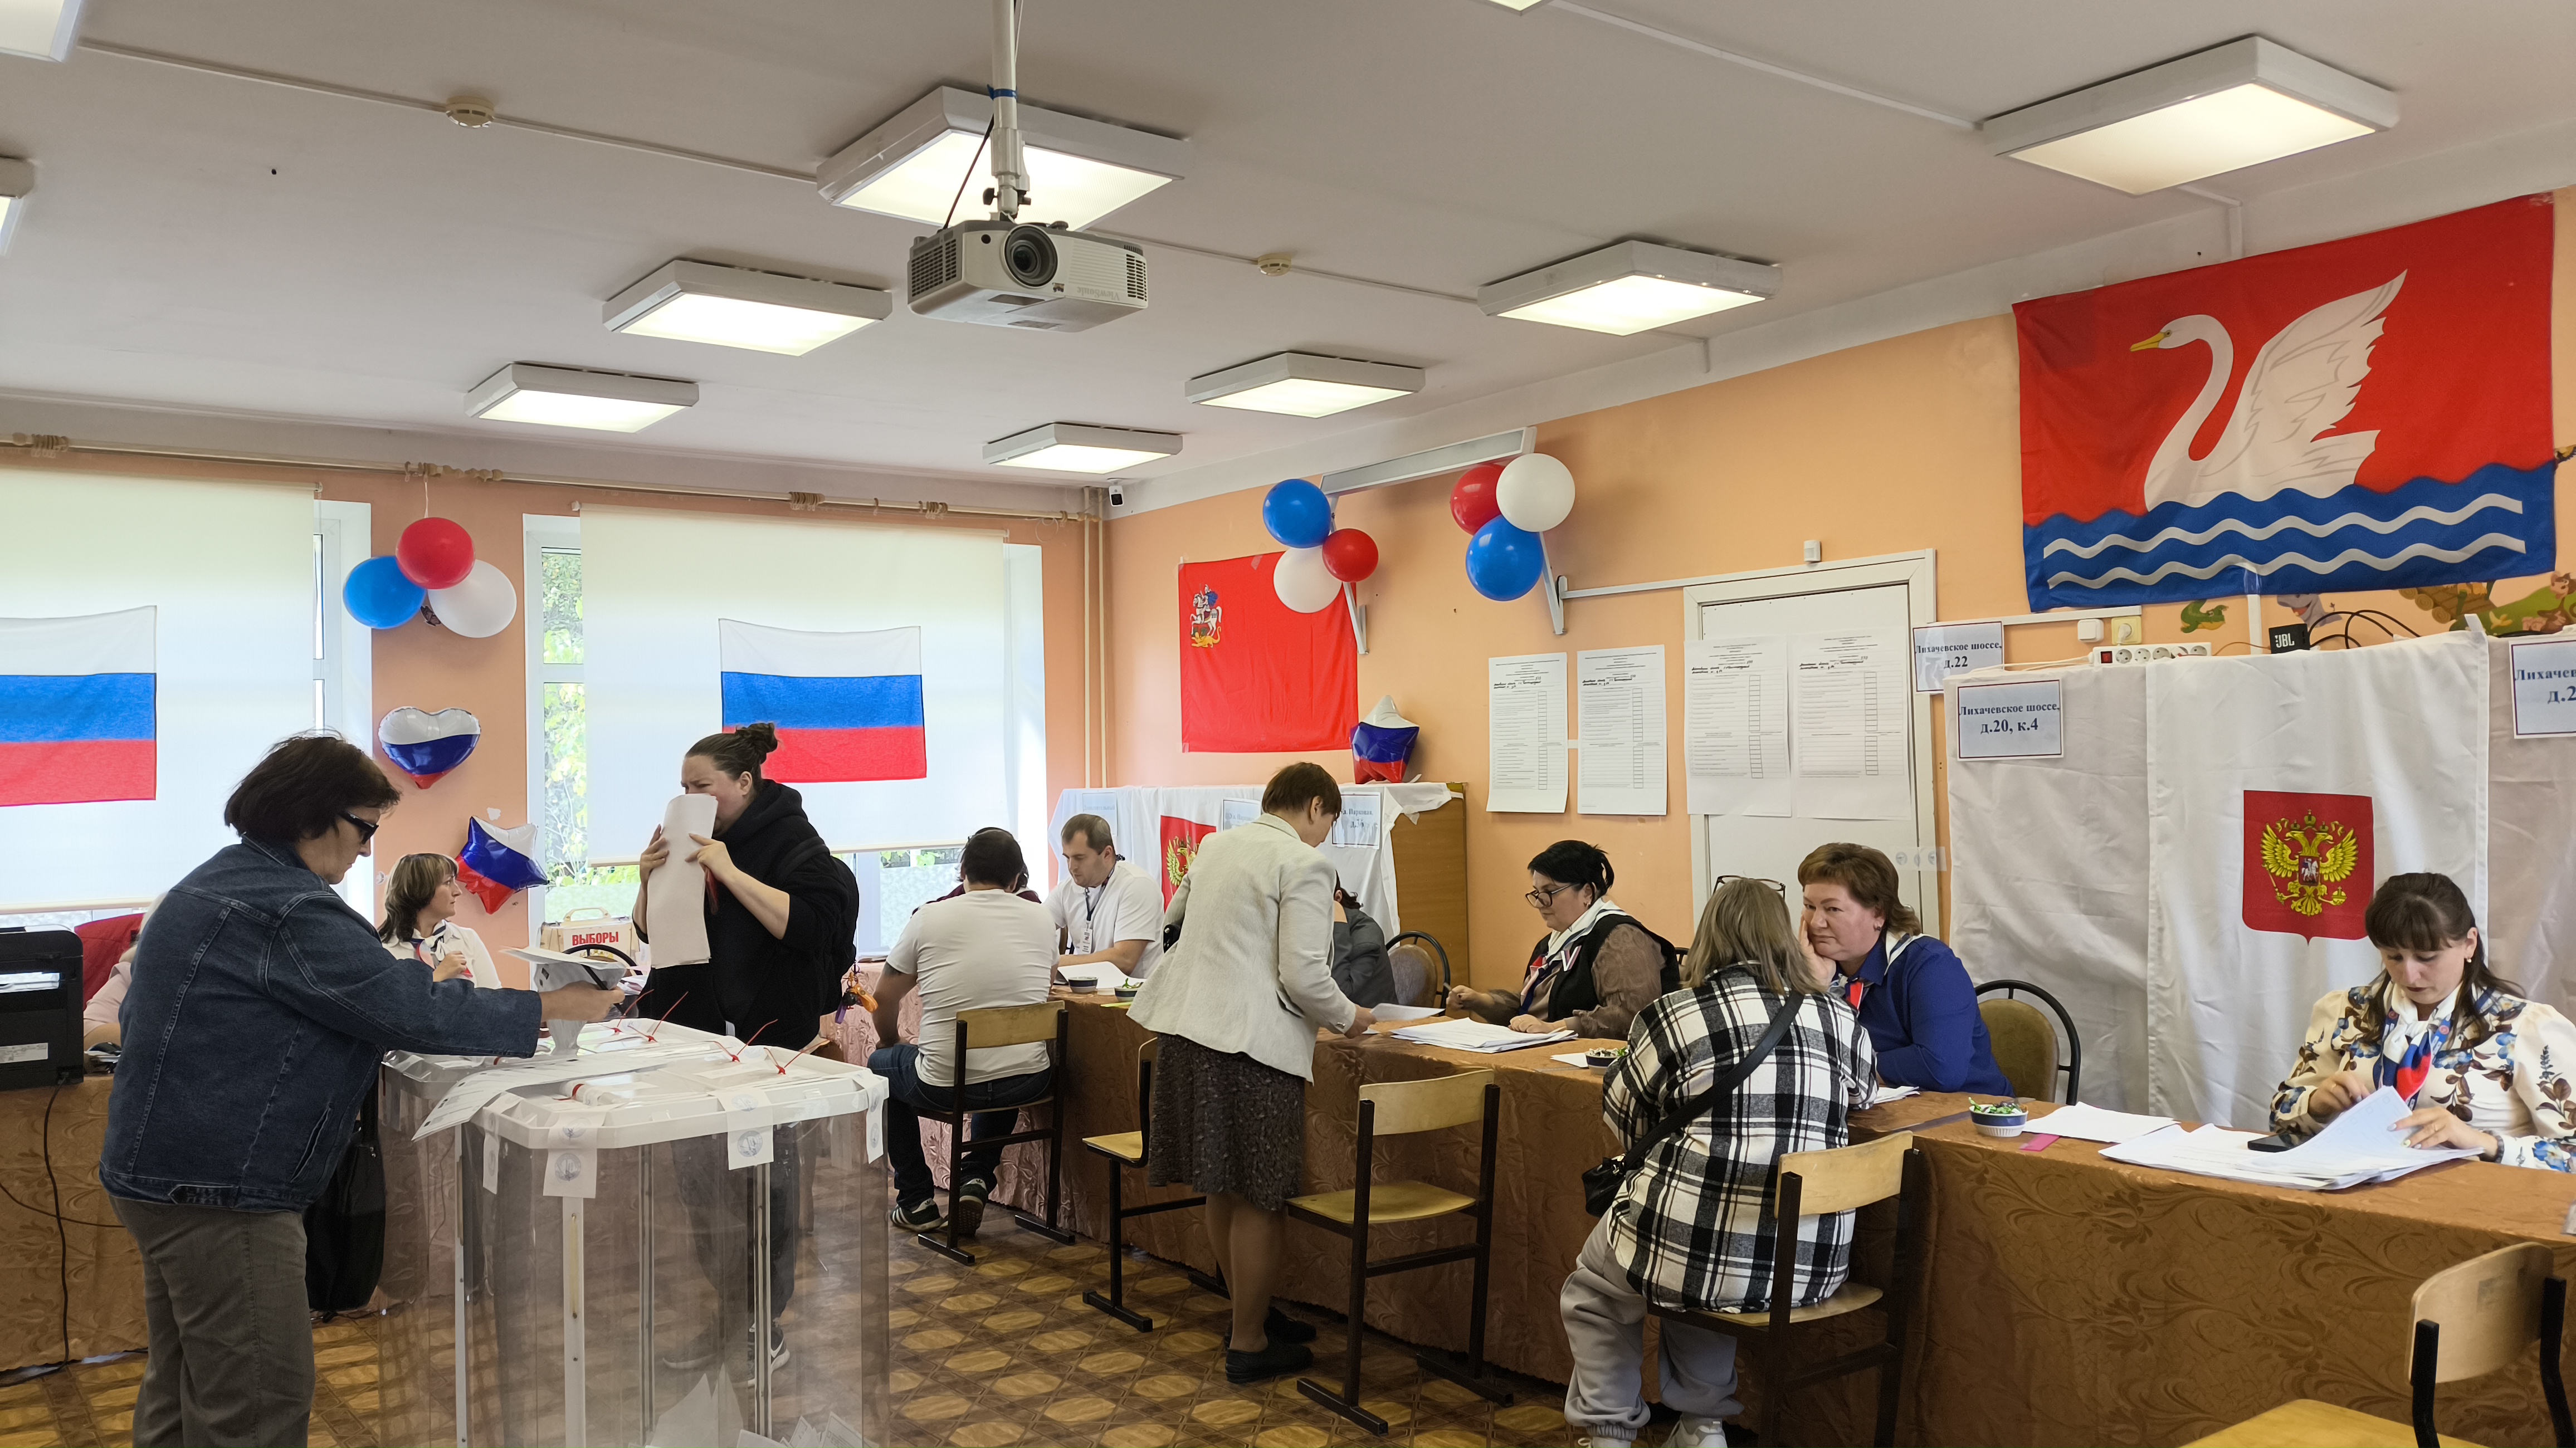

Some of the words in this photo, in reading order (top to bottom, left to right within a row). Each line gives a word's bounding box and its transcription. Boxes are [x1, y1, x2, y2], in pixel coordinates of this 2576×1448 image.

[1077, 286, 1120, 301] ViewSonic
[1915, 643, 1968, 654] Лихачевское
[1971, 642, 2002, 650] шоссе,
[2276, 633, 2295, 648] JBL
[1944, 656, 1968, 669] д.22
[1959, 705, 2023, 716] Лихачевское
[2026, 703, 2060, 712] шоссе,
[1980, 718, 2013, 735] д.20,
[2018, 717, 2038, 731] к.4
[572, 931, 619, 946] ВЫБОРЫ
